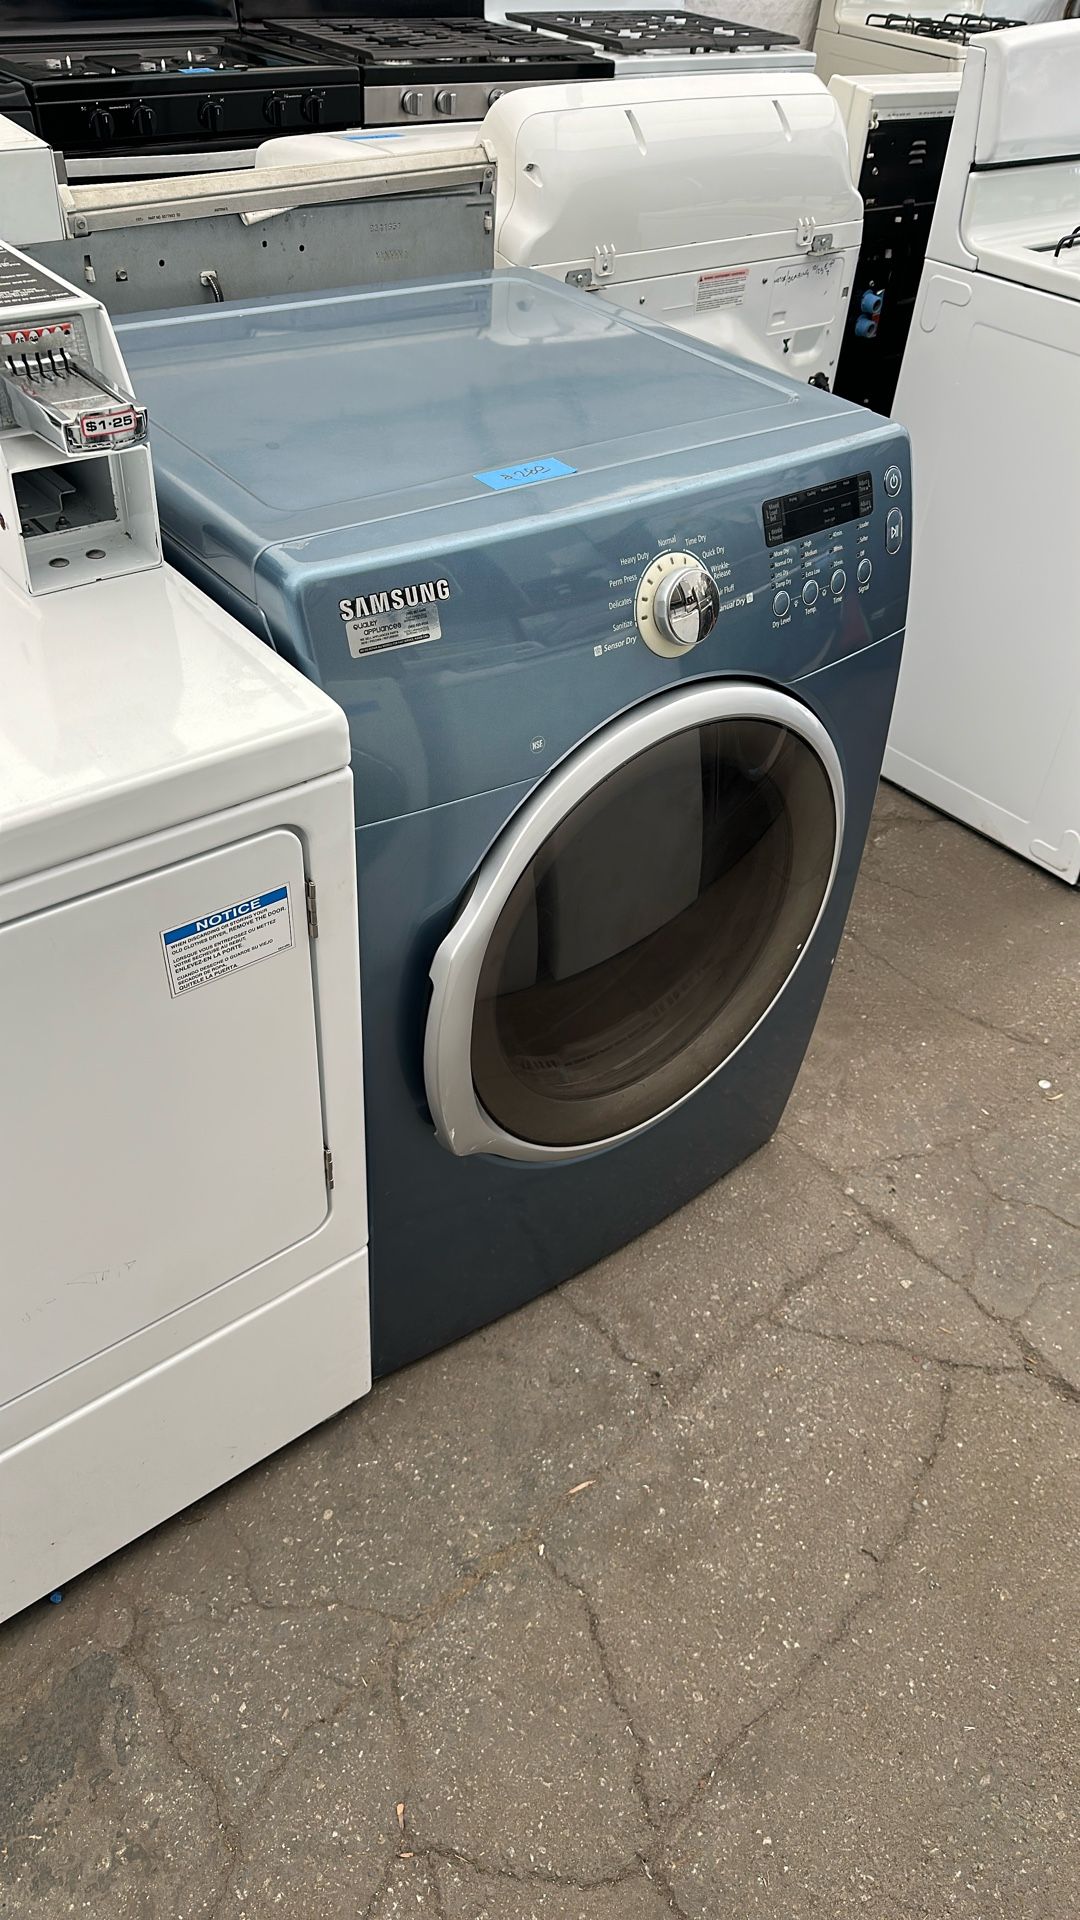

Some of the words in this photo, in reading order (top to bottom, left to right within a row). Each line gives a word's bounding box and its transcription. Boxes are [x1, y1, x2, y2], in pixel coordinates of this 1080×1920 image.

[658, 534, 677, 547] Normal
[685, 537, 697, 546] Time
[698, 534, 707, 543] Dry
[620, 556, 636, 566] Heavy
[637, 552, 649, 561] Duty
[702, 548, 715, 559] Quick
[716, 546, 725, 555] Dry
[804, 549, 818, 558] Medium
[774, 559, 787, 568] Normal
[609, 578, 623, 588] Perm
[623, 573, 638, 584] Press
[713, 569, 732, 580] Release
[805, 570, 814, 578] Extra
[724, 584, 735, 593] Fluff
[775, 581, 786, 589] Damp
[339, 579, 450, 621] SAMSUNG
[608, 597, 633, 610] Delicates
[720, 600, 736, 612] anual
[735, 597, 746, 607] Dry
[612, 620, 633, 632] Sanitize
[772, 620, 780, 629] Dry
[780, 615, 792, 626] Level
[604, 640, 624, 652] Sensor
[625, 636, 637, 645] Dry
[532, 739, 543, 750] NSF
[195, 898, 262, 932] NOTICE
[171, 940, 187, 949] WHEN
[187, 927, 220, 944] DISCARDING
[221, 922, 229, 930] OR
[229, 914, 253, 927] STORING
[253, 908, 268, 918] YOUR
[184, 938, 208, 953] CLOTHES
[228, 919, 254, 933] REMOVE
[254, 914, 267, 923] THE
[173, 951, 198, 963] LORSQUE
[198, 944, 213, 953] VOUS
[213, 931, 247, 948] ENTREPOSEZ
[256, 919, 276, 931] METTEZ
[173, 959, 191, 968] VOTRE
[191, 947, 220, 961] SECHEUSE
[175, 955, 212, 973] ENLEVEZ-EN
[213, 951, 221, 959] LA
[177, 969, 199, 981] CUANDO
[199, 960, 224, 971] DESECHE
[229, 948, 251, 960] GUARDE
[259, 938, 274, 948] VIEJO
[178, 977, 204, 991] QUITELE
[205, 973, 213, 981] LA
[213, 963, 238, 976] PUERTA
[178, 972, 203, 986] SECADOR
